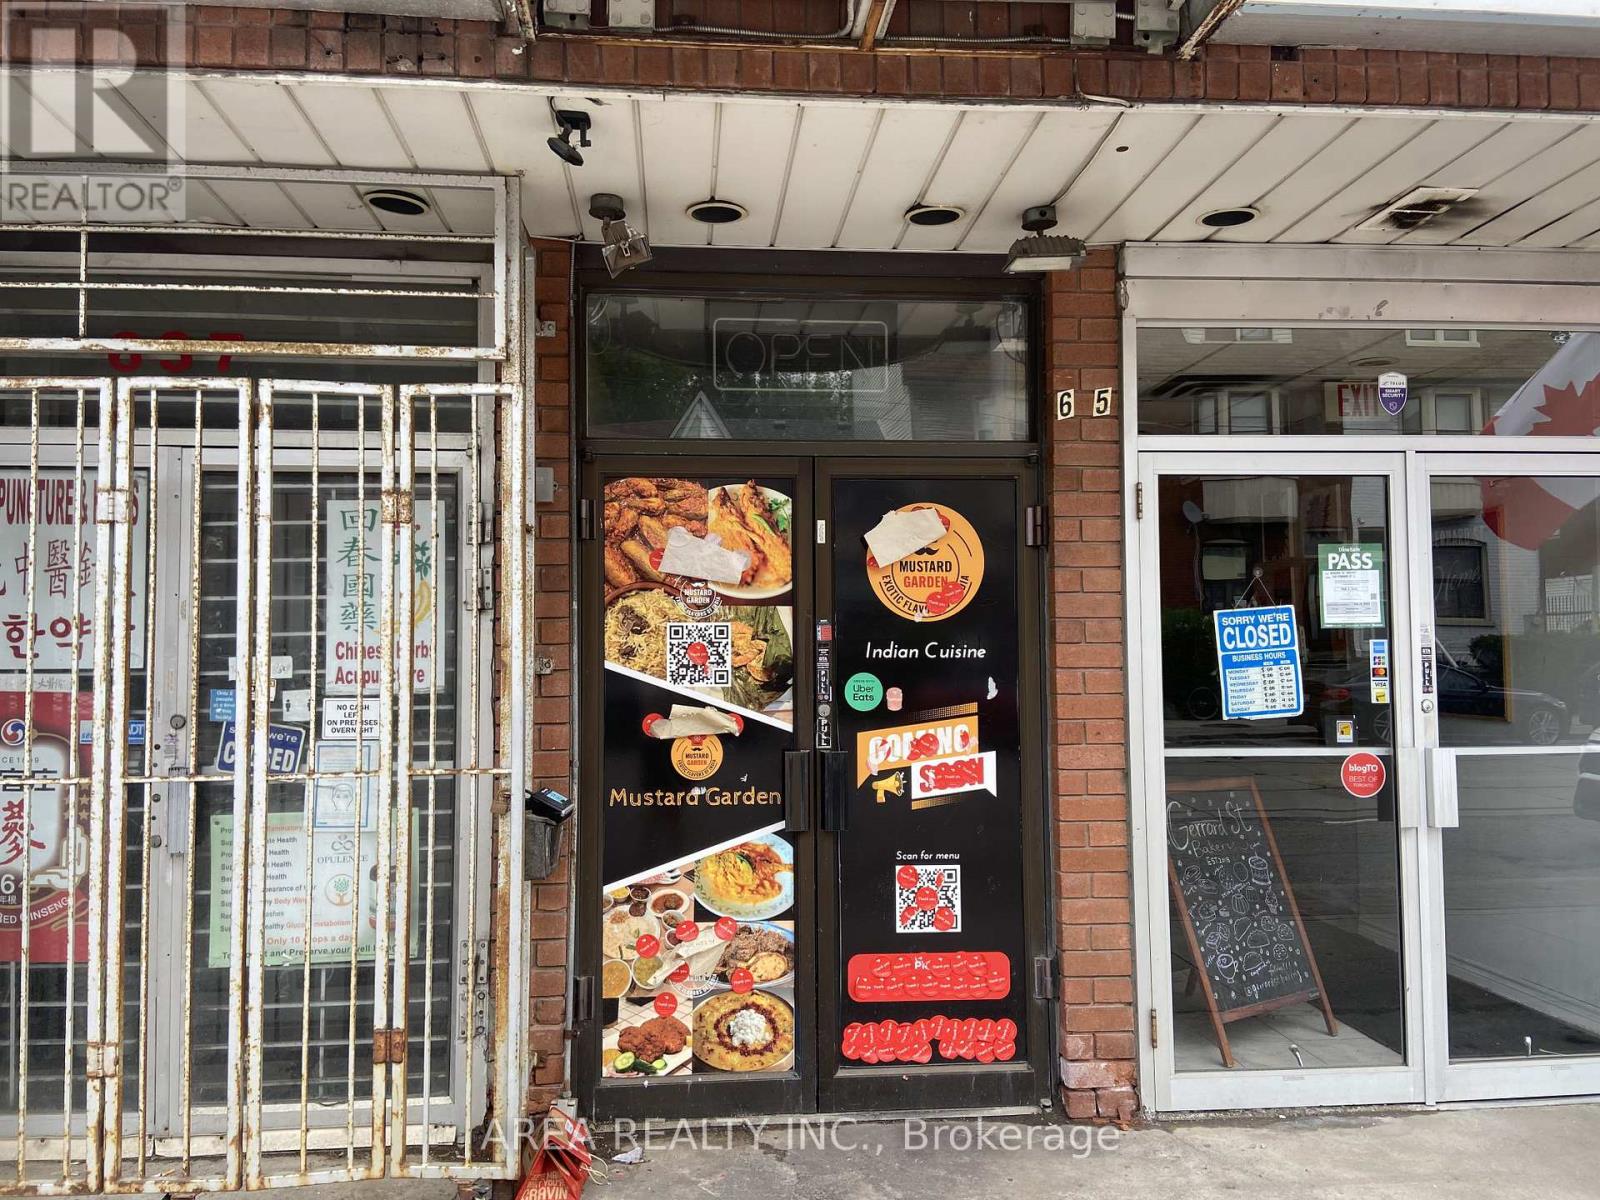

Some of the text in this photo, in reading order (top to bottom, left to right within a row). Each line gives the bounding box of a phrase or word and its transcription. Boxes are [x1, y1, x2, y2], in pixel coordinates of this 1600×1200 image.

[726, 332, 873, 375] OPEN
[1337, 383, 1379, 417] EXIT
[900, 560, 952, 573] MUSTARD
[1328, 552, 1373, 570] PASS
[904, 576, 948, 588] GARDEN
[684, 588, 713, 596] MUSTARD
[882, 575, 904, 605] EXOTIC
[1222, 613, 1290, 626] SORRY WE'RE
[1223, 623, 1292, 650] CLOSED
[866, 641, 987, 660] Indian Cuisine
[1232, 651, 1286, 662] BUSINESS HOURS
[852, 684, 874, 693] Uber
[853, 693, 875, 702] Eats
[820, 719, 828, 746] PULL
[1349, 763, 1378, 774] blogTO
[1349, 775, 1378, 783] BEST OF
[705, 786, 782, 806] Garden
[1225, 801, 1252, 834] St
[269, 848, 289, 856] Health
[896, 850, 960, 861] Scan for menu
[317, 854, 369, 865] OPULENE
[0, 873, 15, 894] 6
[266, 937, 287, 946] Only
[291, 936, 299, 944] 10
[330, 946, 351, 955] your
